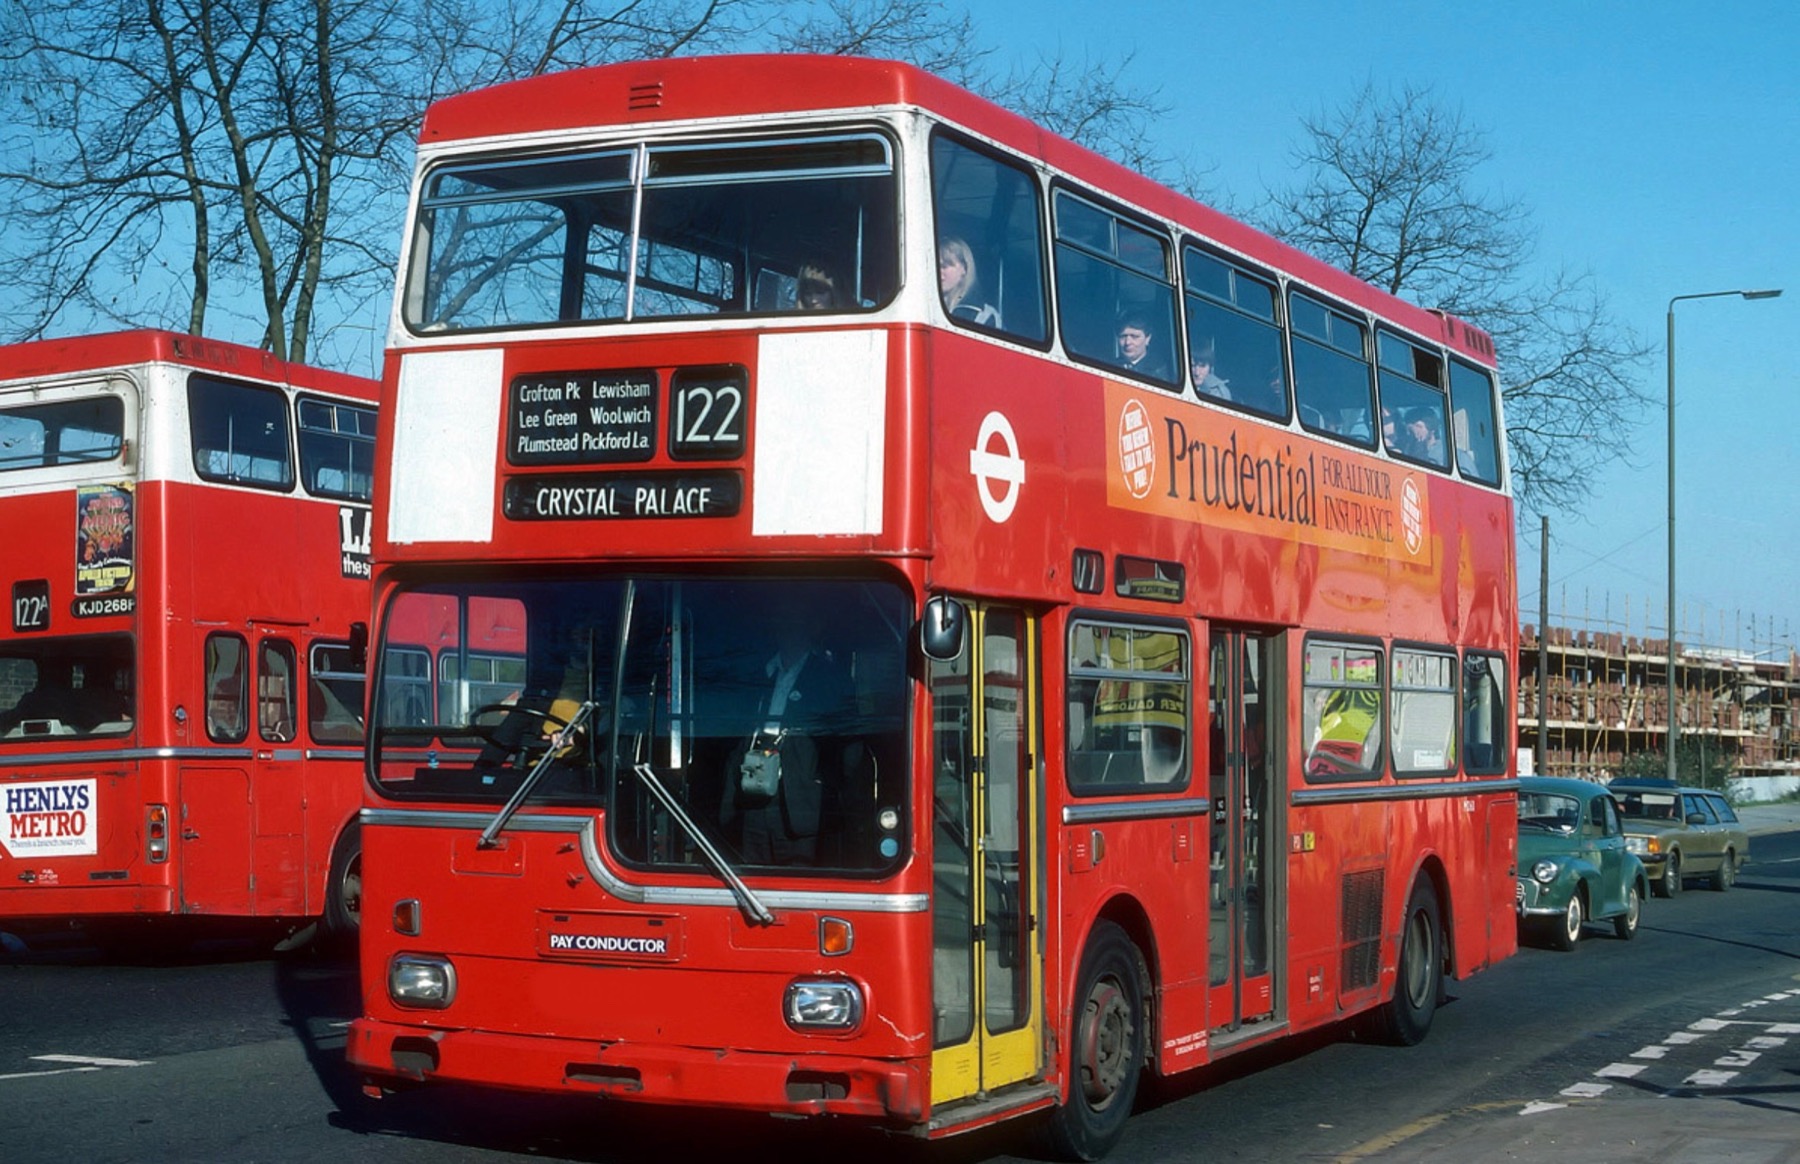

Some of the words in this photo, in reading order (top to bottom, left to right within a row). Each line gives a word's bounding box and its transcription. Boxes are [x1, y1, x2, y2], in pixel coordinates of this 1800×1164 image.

[520, 385, 561, 403] Crofton
[566, 382, 581, 400] Pk
[593, 381, 650, 400] Lewisham
[519, 411, 540, 428] Lee
[544, 408, 577, 427] Green
[590, 406, 651, 425] Woolwich
[676, 386, 742, 442] 122
[518, 435, 578, 453] Plumstead
[582, 432, 630, 451] Pickford
[1164, 416, 1318, 527] Prudential
[1322, 455, 1345, 489] FOR
[1344, 463, 1366, 495] ALL
[1364, 467, 1393, 502] YOUR
[536, 488, 620, 515] CRYSTAL
[1323, 495, 1394, 543] INSURANCE
[6, 785, 89, 813] HENLYS
[10, 810, 86, 838] METRO
[550, 934, 574, 949] PAY
[576, 936, 666, 953] CONDUCTOR
